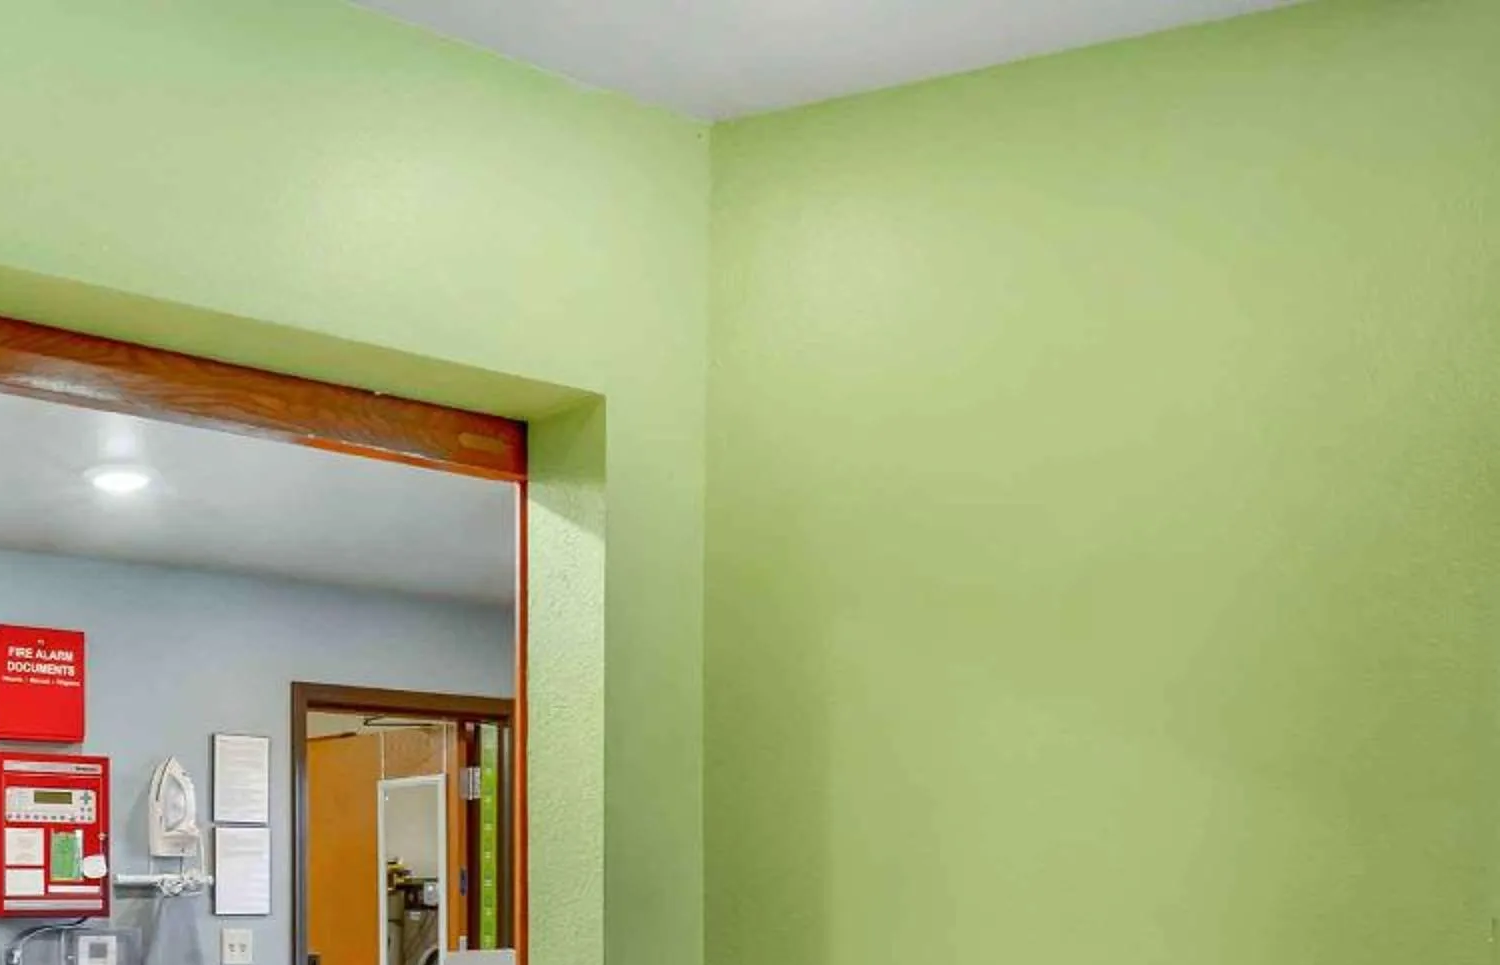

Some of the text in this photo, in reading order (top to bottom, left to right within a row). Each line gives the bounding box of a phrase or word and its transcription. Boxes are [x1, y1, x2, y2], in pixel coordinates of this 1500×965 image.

[8, 646, 74, 662] FIRE ALARM
[7, 661, 76, 677] DOCUMENTS
